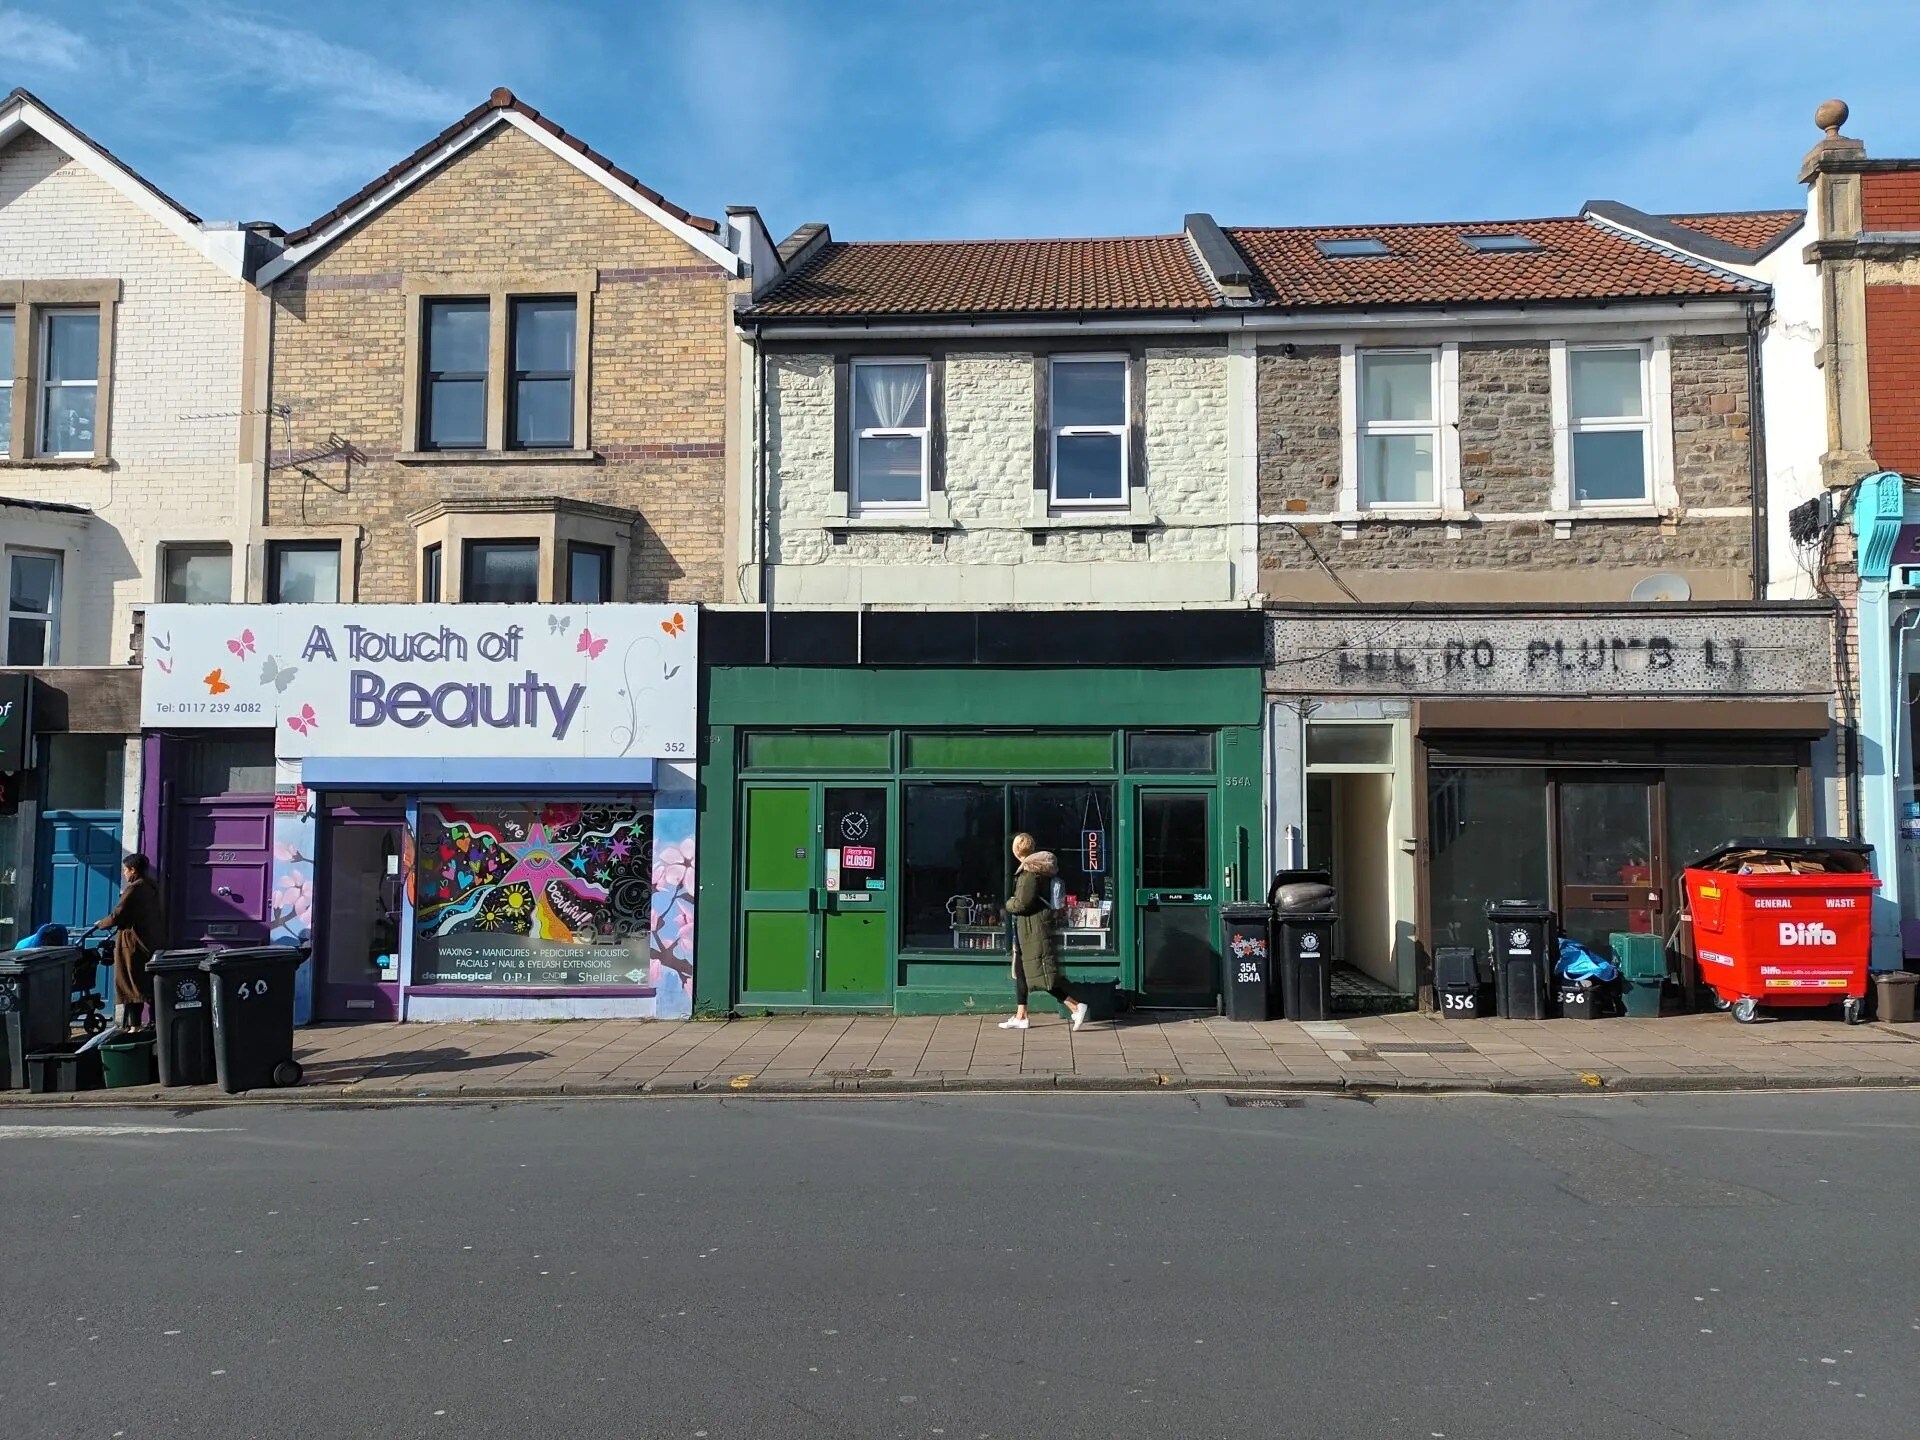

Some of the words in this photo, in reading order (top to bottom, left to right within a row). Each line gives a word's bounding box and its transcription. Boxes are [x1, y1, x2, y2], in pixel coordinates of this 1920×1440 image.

[301, 624, 337, 662] A
[343, 624, 468, 663] Touch
[476, 624, 524, 663] of
[157, 703, 175, 713] Tel:
[179, 703, 206, 713] 0117
[210, 703, 230, 713] 239
[234, 703, 261, 713] 4082
[349, 669, 587, 741] Beauty
[664, 742, 685, 752] 352
[1225, 776, 1251, 787] 354A
[504, 819, 525, 839] are
[217, 852, 237, 861] 352
[1088, 832, 1098, 870] OPEN
[845, 854, 873, 867] CLOSED
[1193, 893, 1213, 901] 354A
[1755, 899, 1793, 908] GENERAL
[1826, 899, 1855, 908] WASTE
[1779, 922, 1837, 945] Biffa
[439, 948, 473, 957] WAXING
[482, 948, 530, 957] MANICURES
[540, 948, 584, 957] PEDICURES
[594, 948, 630, 957] HOLISTIC
[456, 959, 489, 968] FACIALS
[498, 960, 517, 968] NAIL
[518, 960, 525, 968] &
[527, 960, 561, 969] EYELASH
[563, 960, 612, 969] EXTENSIONS
[1240, 962, 1257, 973] 354
[1760, 965, 1781, 975] Biffa
[422, 971, 493, 982] dermalogica
[542, 971, 561, 980] CND
[578, 971, 620, 983] Shellac
[1237, 972, 1261, 983] 354A
[1444, 993, 1475, 1010] 356
[1556, 991, 1586, 1004] 356
